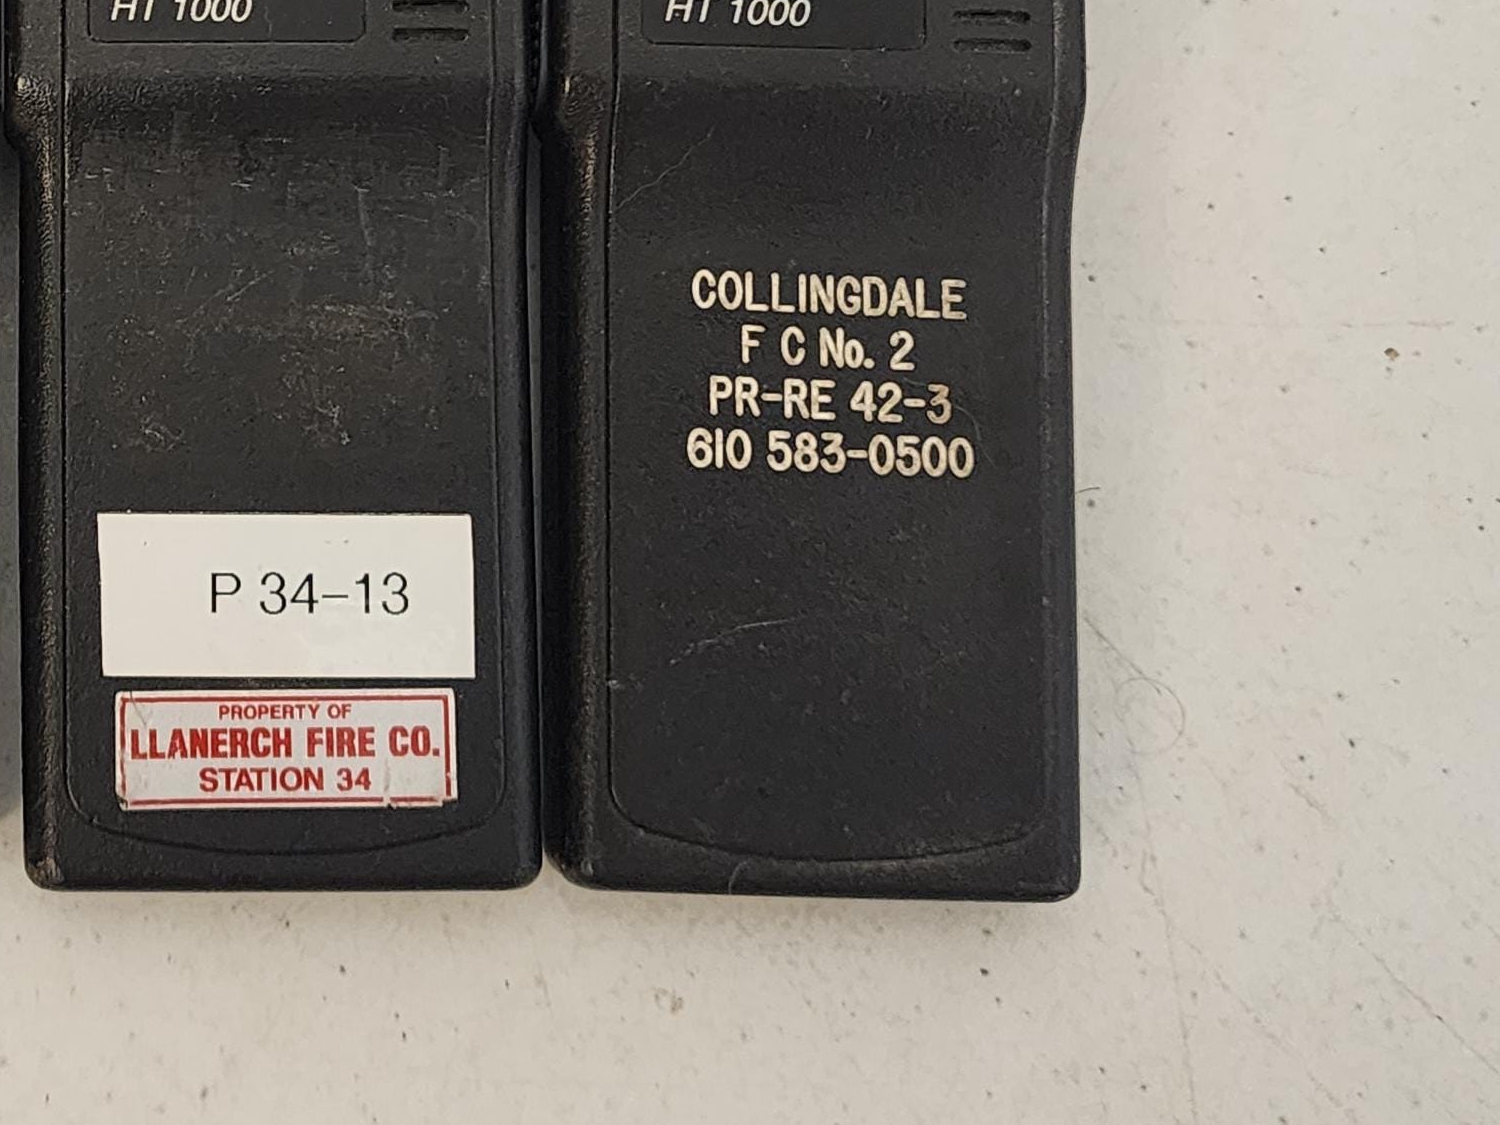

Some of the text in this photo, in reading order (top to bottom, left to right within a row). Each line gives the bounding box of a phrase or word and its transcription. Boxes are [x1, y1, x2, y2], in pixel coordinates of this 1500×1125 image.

[691, 268, 967, 320] COLLINGDALE
[741, 324, 915, 371] F C No. 2
[709, 375, 952, 424] PR-RE 42-3
[686, 427, 975, 478] 610 583-0500
[211, 571, 409, 616] P 34-13
[217, 702, 353, 720] PROPERTY OF
[129, 725, 441, 761] LLANERCH FIRE CO.
[198, 766, 373, 795] STATION 34
